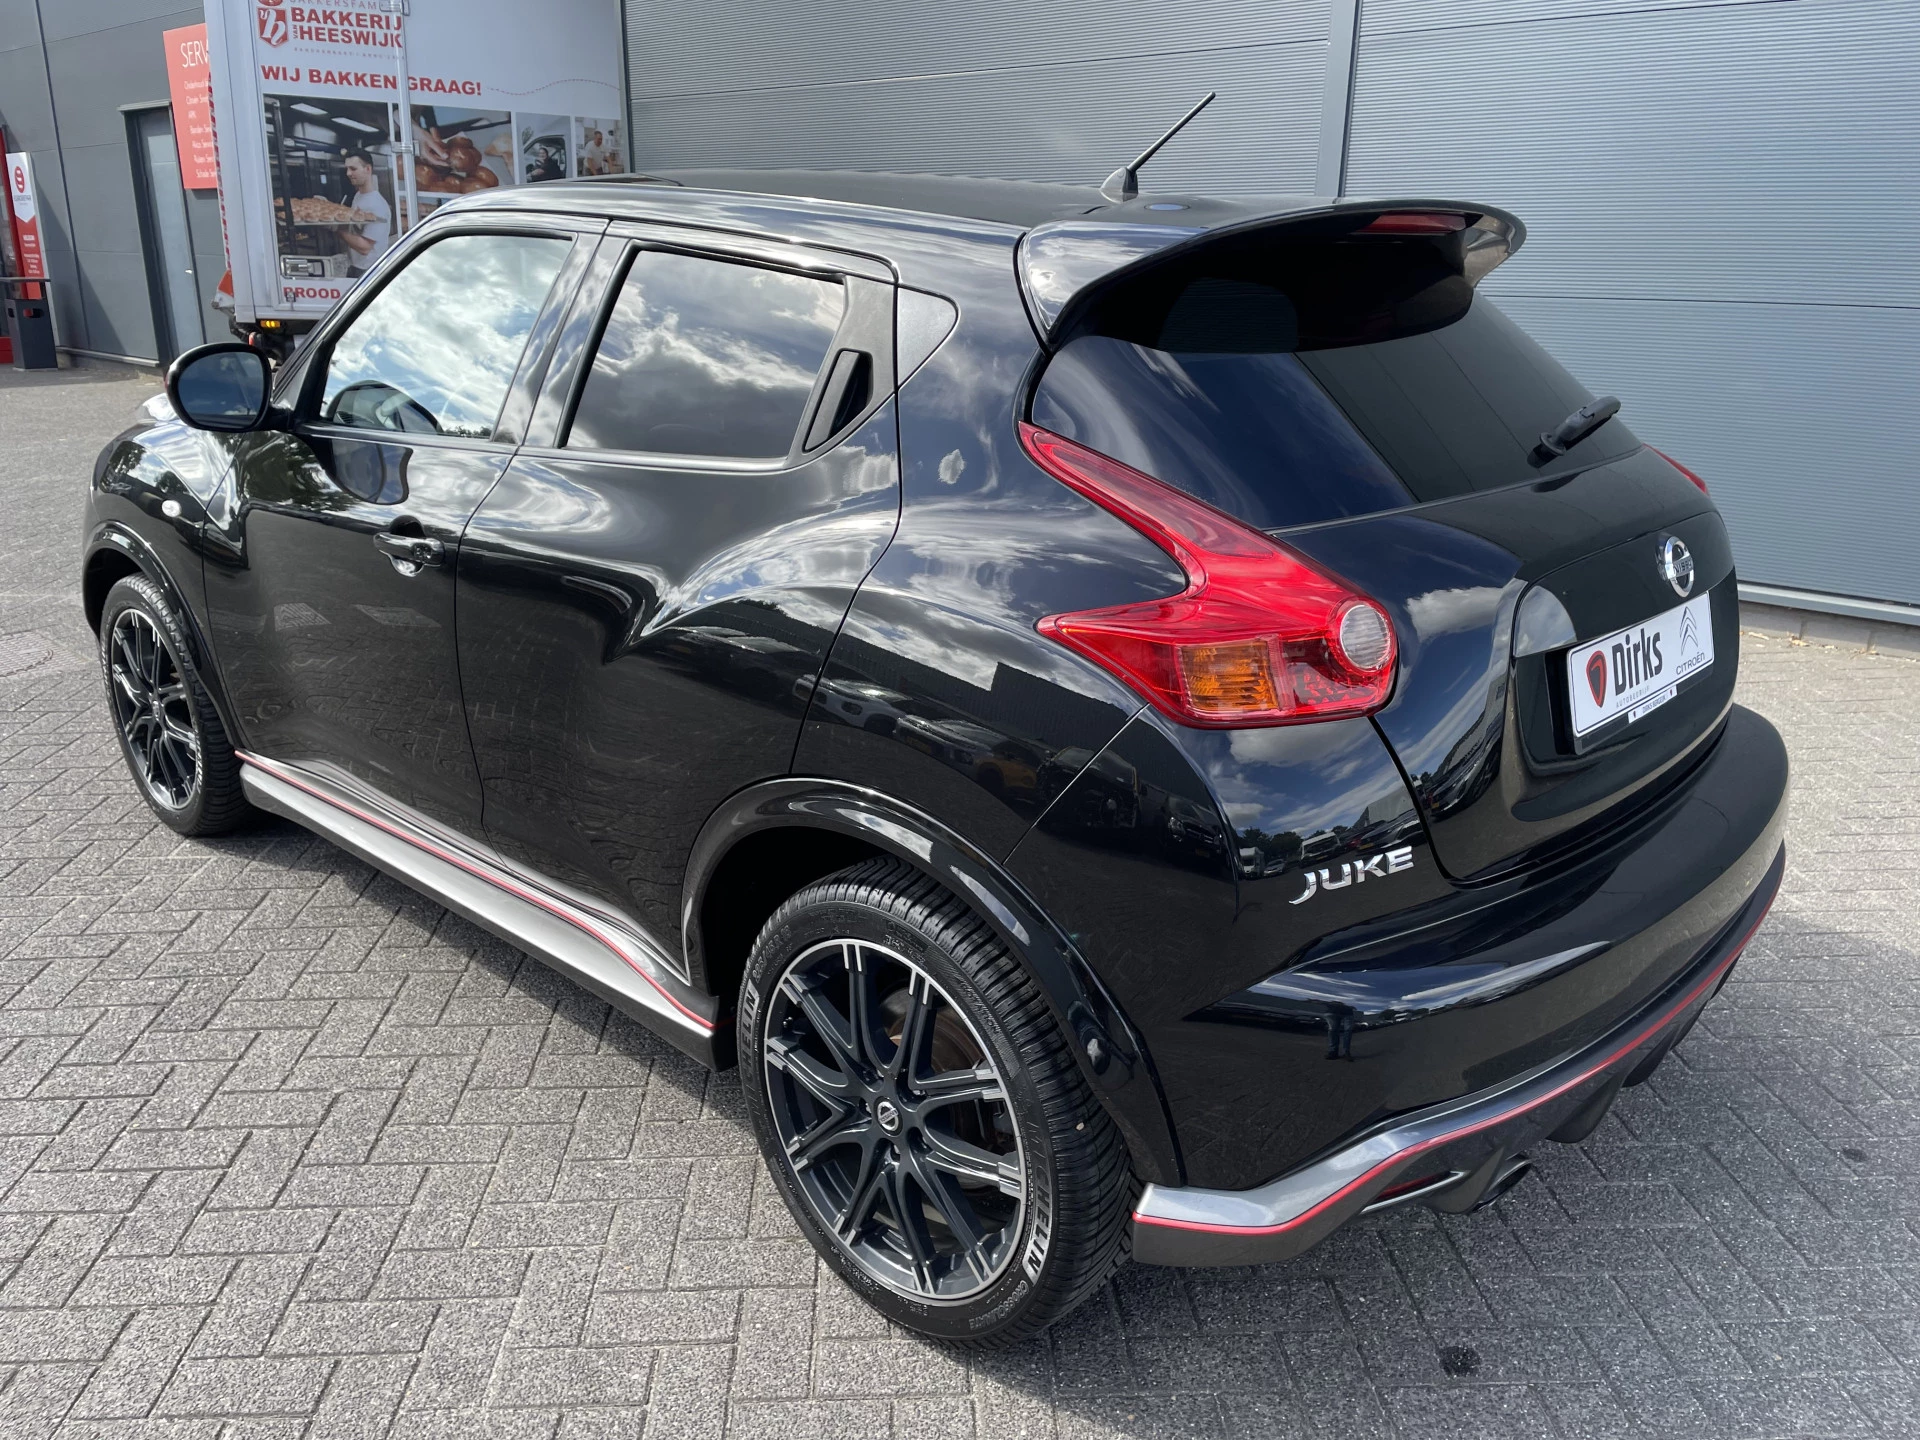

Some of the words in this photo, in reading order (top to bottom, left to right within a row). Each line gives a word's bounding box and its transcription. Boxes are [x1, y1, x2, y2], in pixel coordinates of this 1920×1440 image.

[291, 7, 401, 31] BAKKERIJ
[299, 25, 403, 48] HEESWIJK
[261, 65, 300, 82] WIJ
[308, 69, 398, 90] BAKKEN
[408, 76, 482, 96] GRAAG!
[1611, 628, 1663, 696] Dirks
[1289, 846, 1414, 905] JUKE
